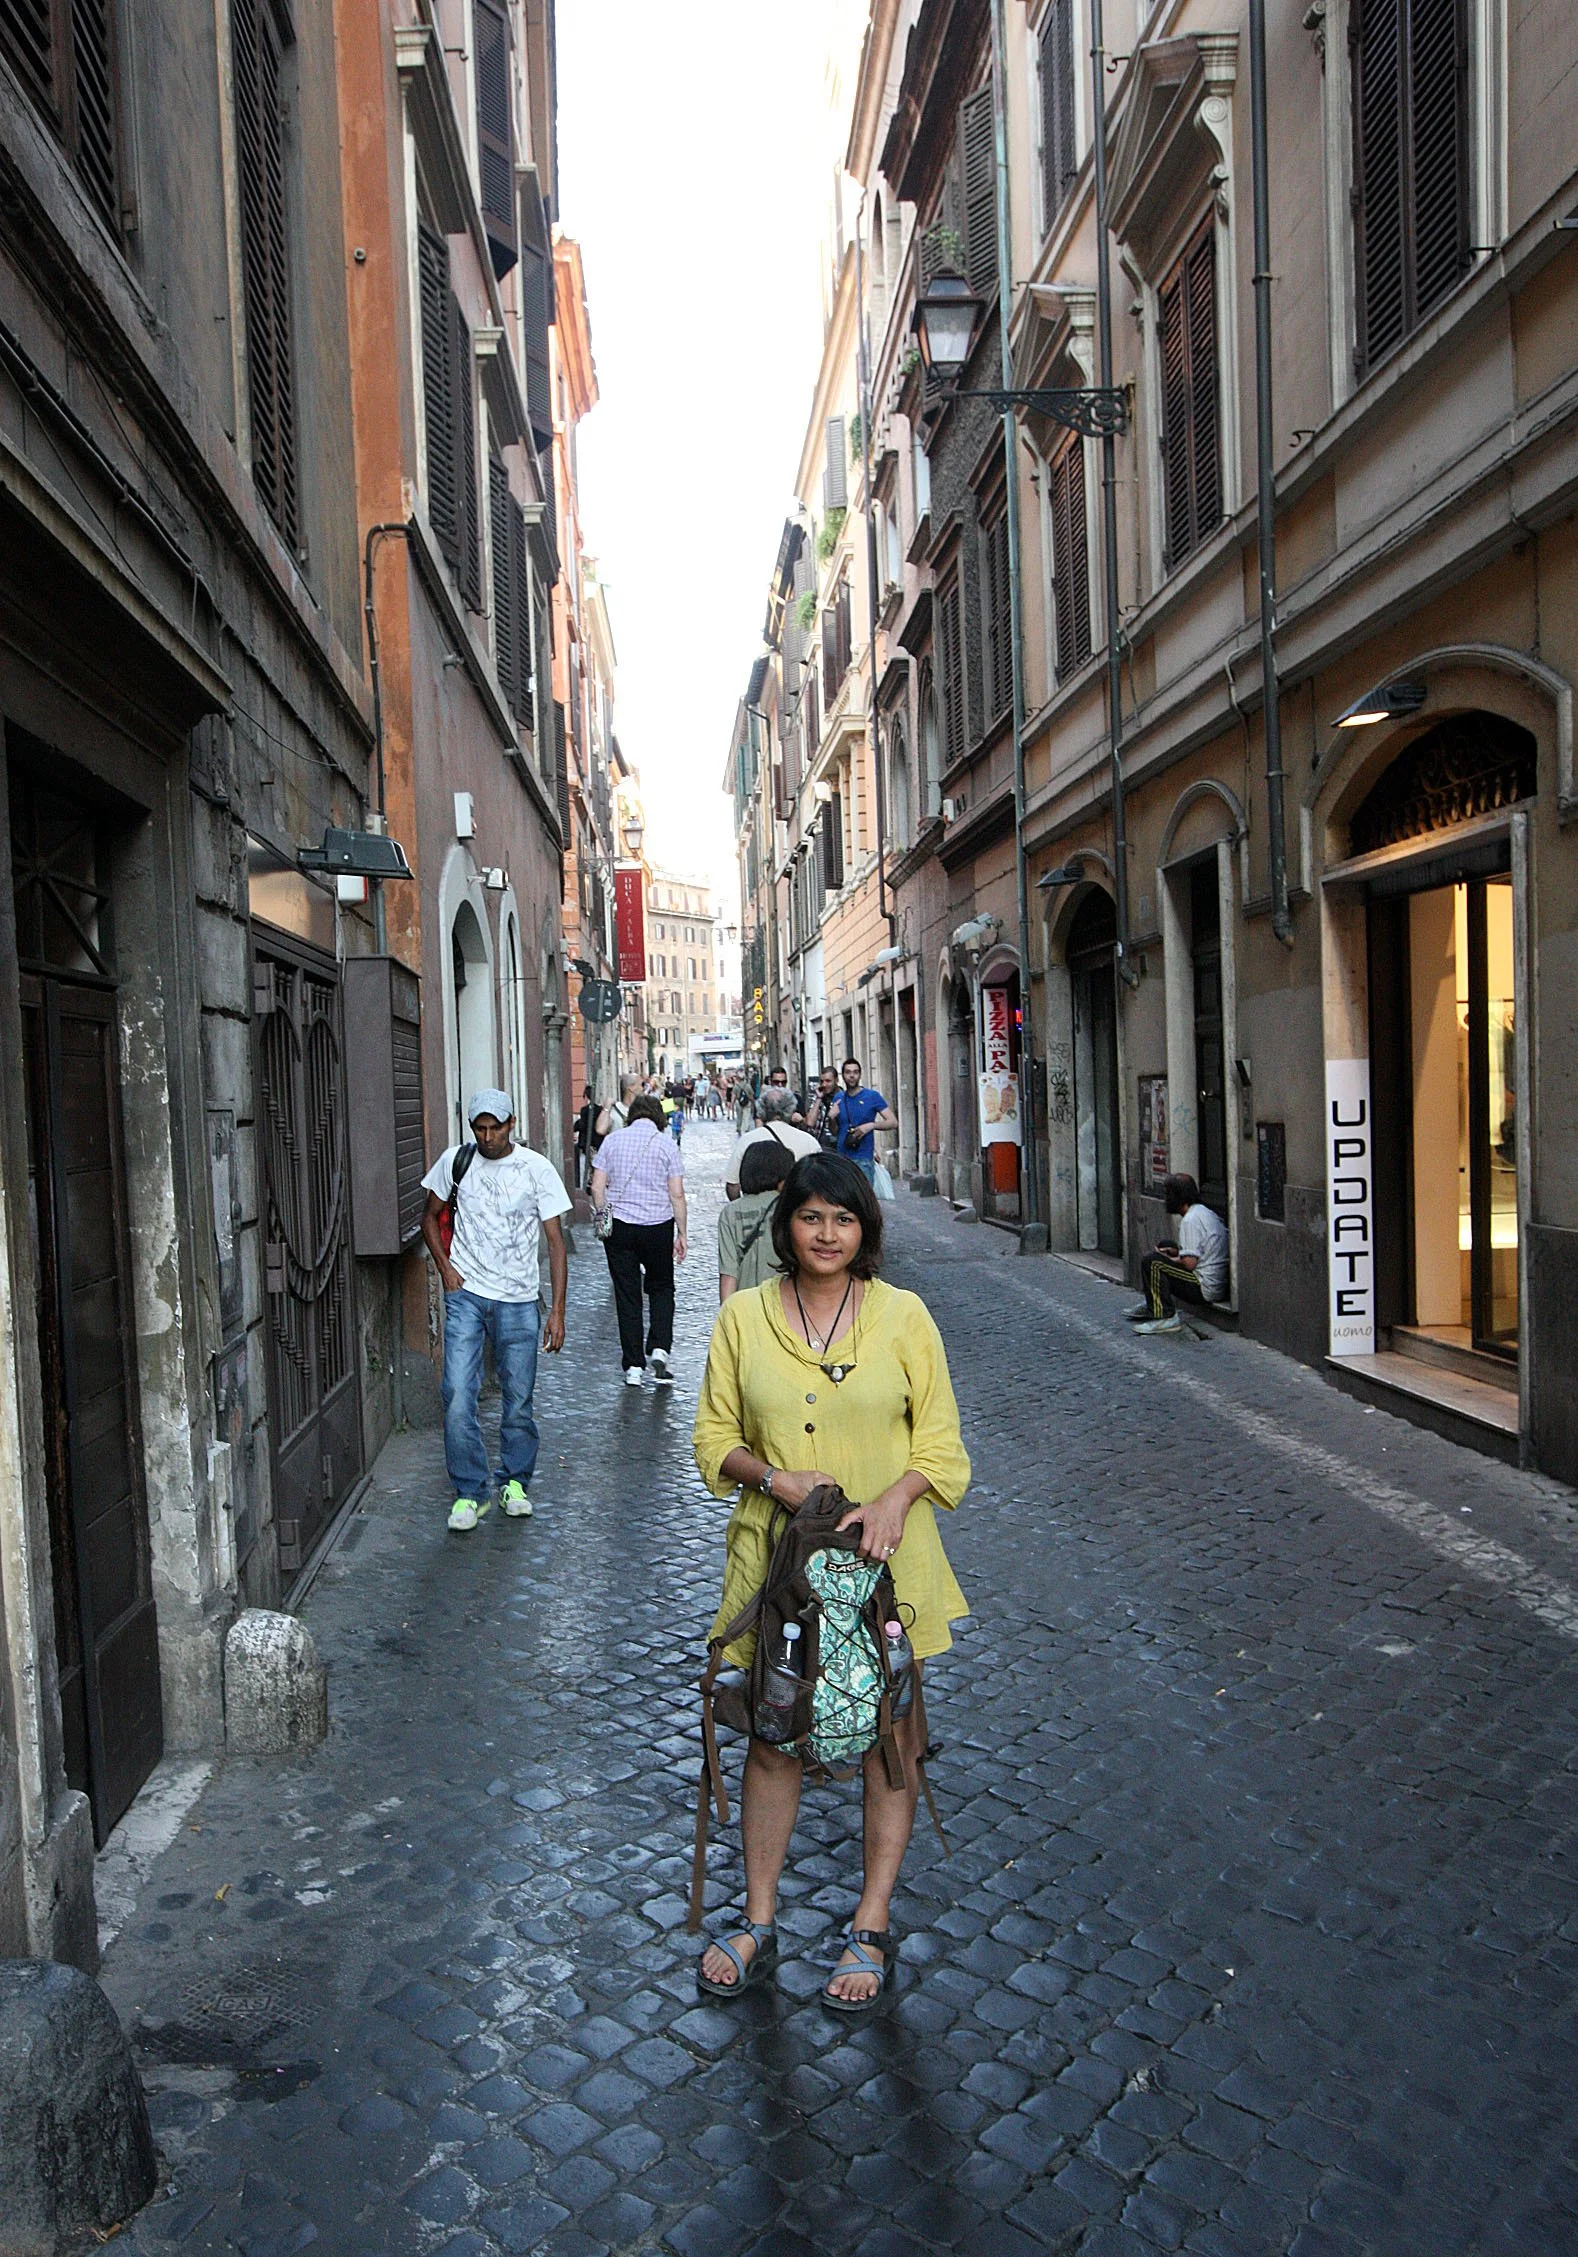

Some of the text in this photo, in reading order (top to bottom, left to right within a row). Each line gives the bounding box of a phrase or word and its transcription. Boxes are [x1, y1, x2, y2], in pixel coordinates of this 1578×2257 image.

[988, 991, 1007, 1040] PIZZA
[989, 1051, 1009, 1073] PA
[1331, 1099, 1369, 1317] UPDATE
[1333, 1325, 1373, 1338] uomo
[222, 1996, 264, 2010] GAS
